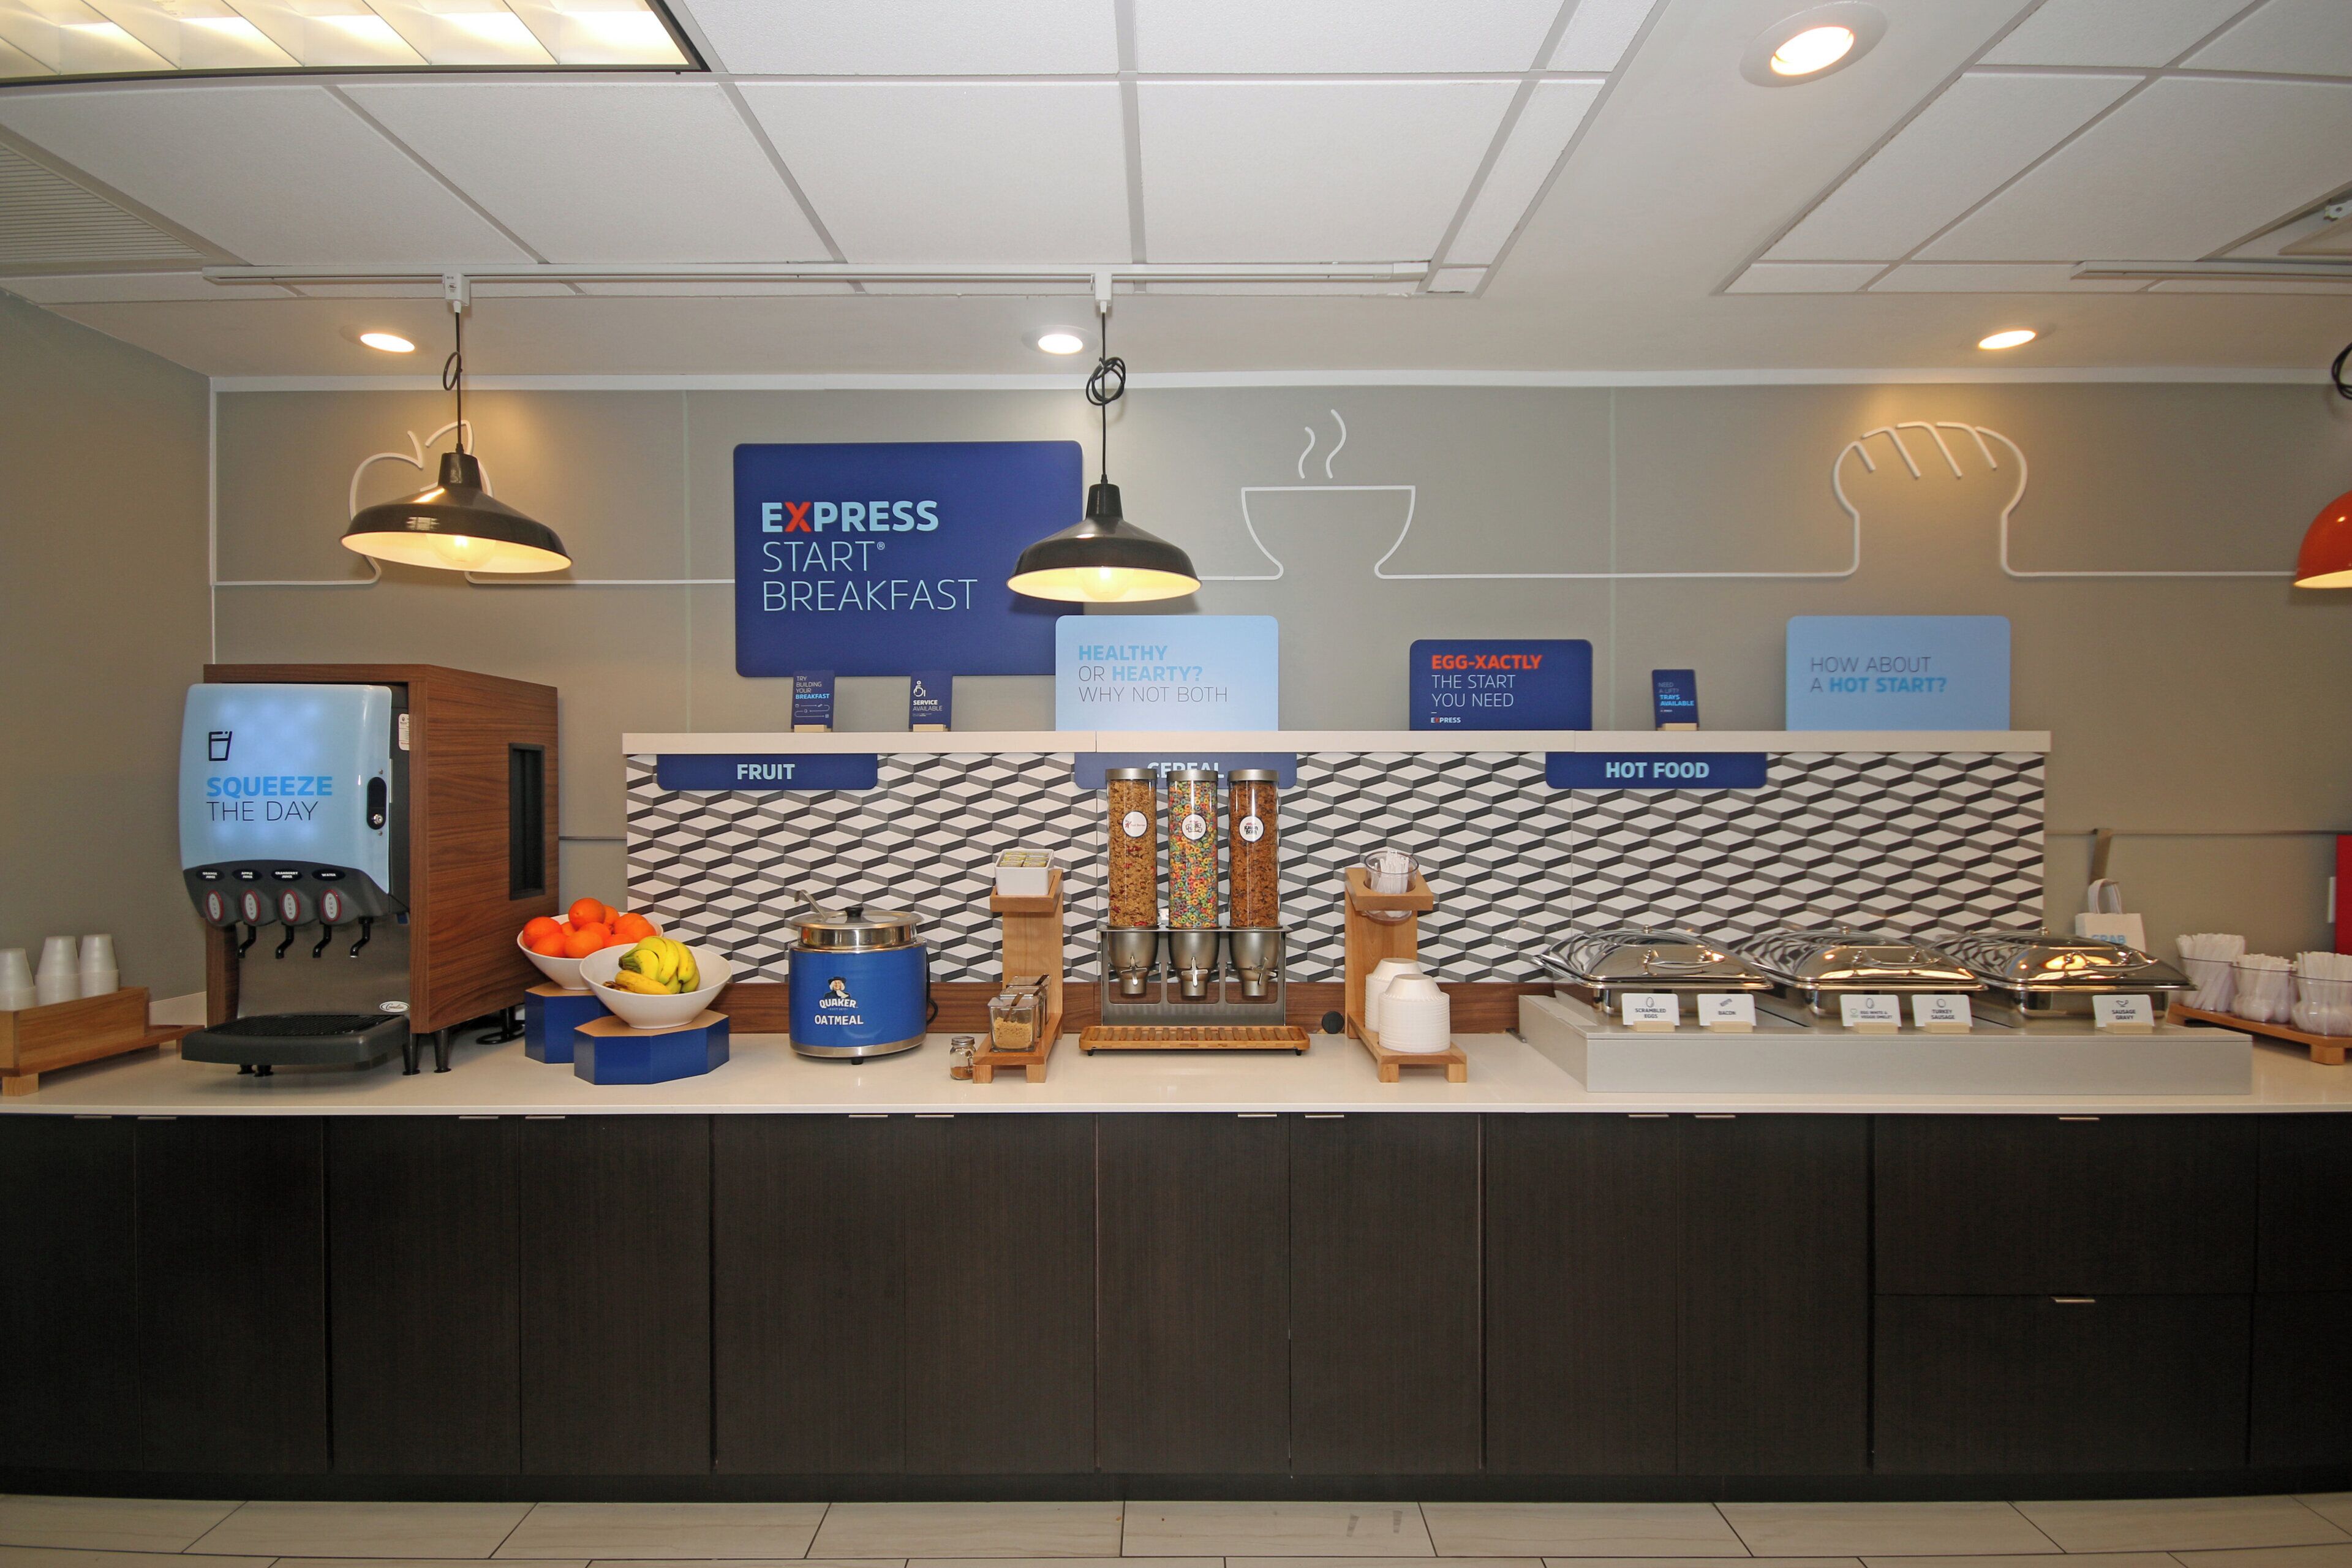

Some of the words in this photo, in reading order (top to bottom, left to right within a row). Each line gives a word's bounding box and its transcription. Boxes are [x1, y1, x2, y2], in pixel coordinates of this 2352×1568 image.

[762, 500, 939, 532] EXPRESS
[763, 579, 978, 611] BREAKFAST
[1079, 645, 1168, 660] HEALTHY
[1431, 655, 1542, 669] EGG-XACTLY
[1811, 657, 1859, 673] HOW
[1866, 657, 1931, 673] ABOUT
[1079, 666, 1104, 682] OR
[1112, 666, 1203, 682] HEARTY?
[1431, 674, 1461, 688] THE
[1468, 674, 1516, 688] START
[1810, 677, 1823, 693] A
[1829, 677, 1869, 693] HOT
[1876, 677, 1947, 693] START?
[1079, 687, 1125, 702] WHY
[1133, 687, 1169, 702] NOT
[1177, 687, 1227, 702] BOTH
[1431, 693, 1465, 707] YOU
[1472, 693, 1514, 707] NEED
[737, 763, 795, 780] FRUIT
[1605, 762, 1648, 778] HOT
[1654, 761, 1709, 778] FOOD
[206, 776, 333, 799] SQUEEZE
[206, 801, 254, 821] THE
[266, 801, 318, 821] DAY
[819, 998, 857, 1008] QUAKER
[815, 1014, 864, 1025] OATMEAL
